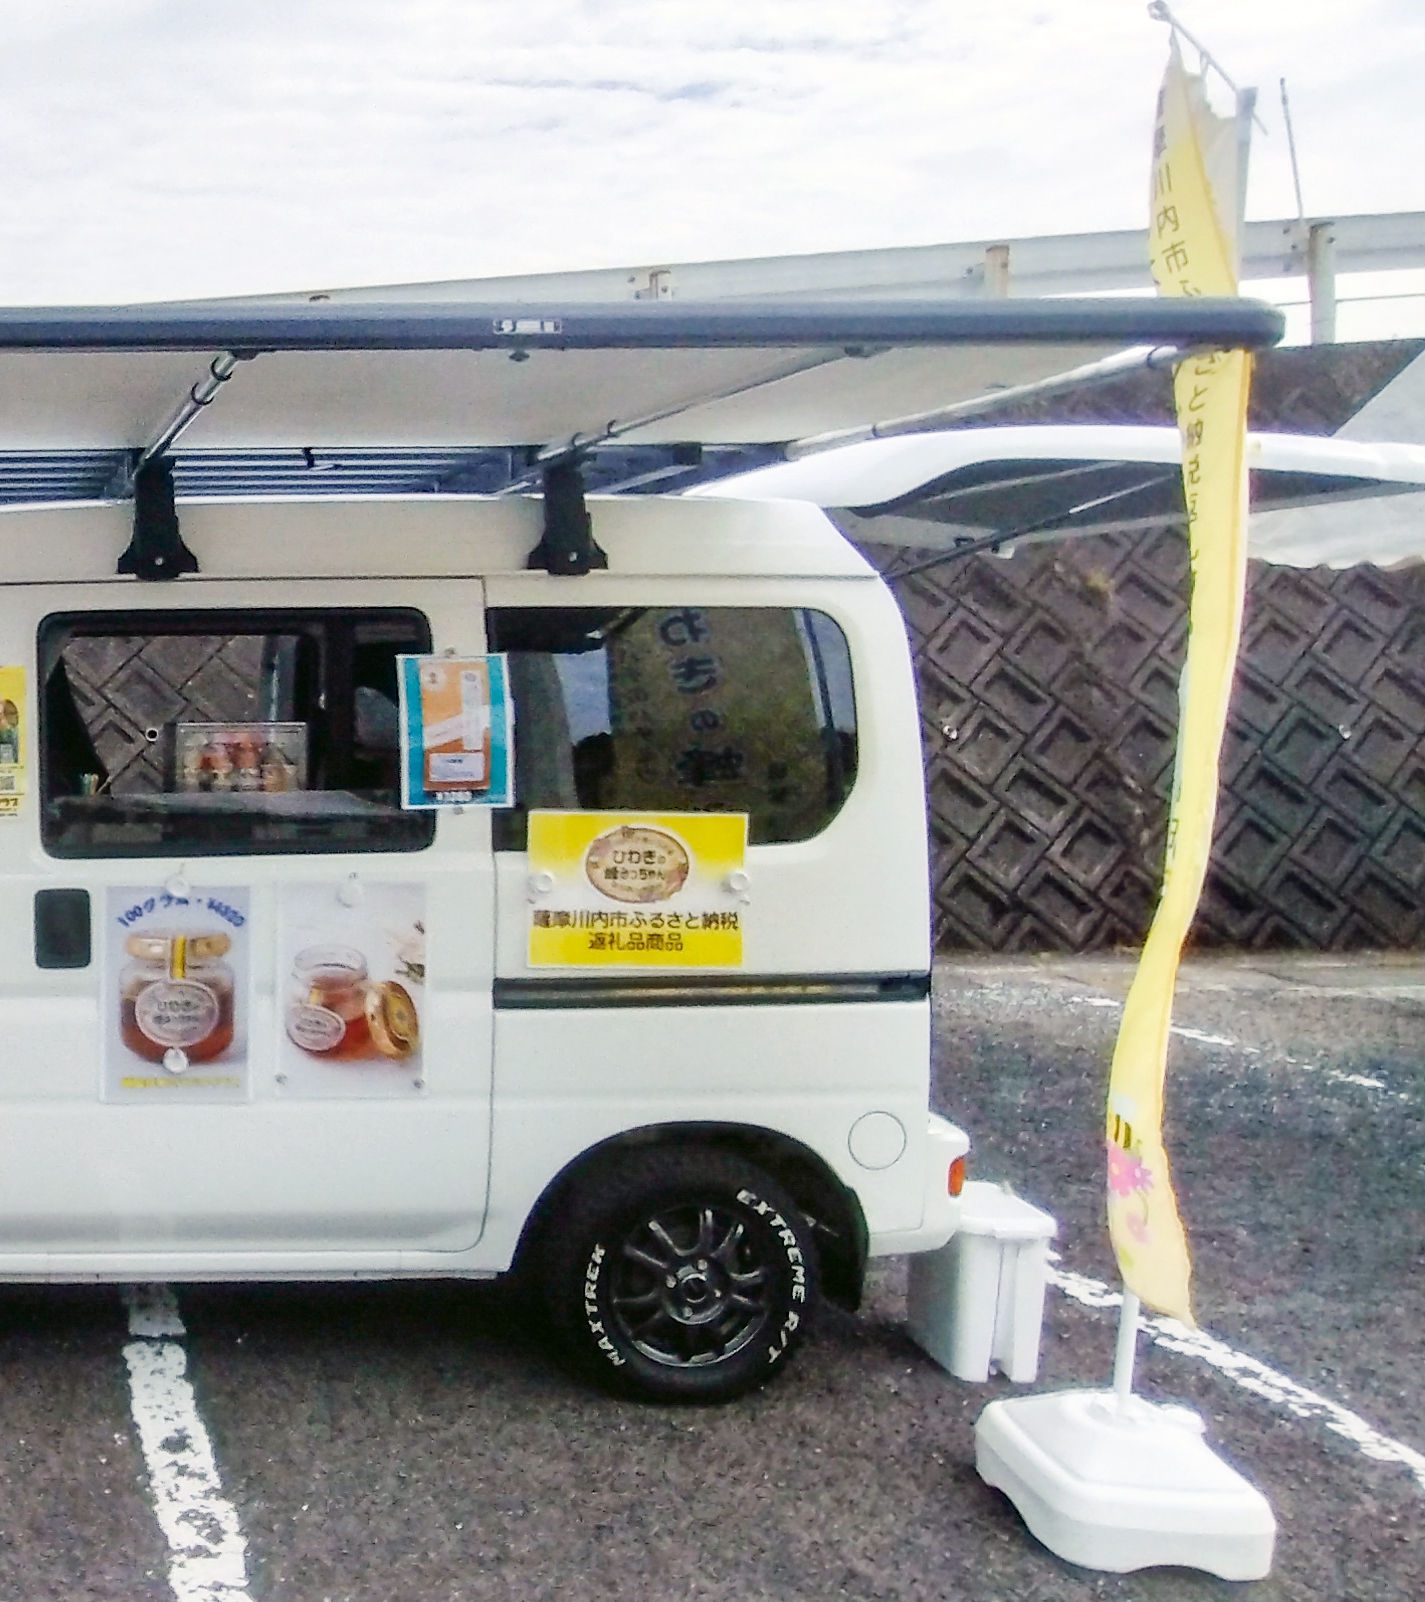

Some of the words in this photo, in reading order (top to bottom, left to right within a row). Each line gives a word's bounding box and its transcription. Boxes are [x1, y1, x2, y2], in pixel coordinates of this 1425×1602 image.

[588, 932, 684, 952] 返礼品商品
[736, 1188, 806, 1304] EXTREME
